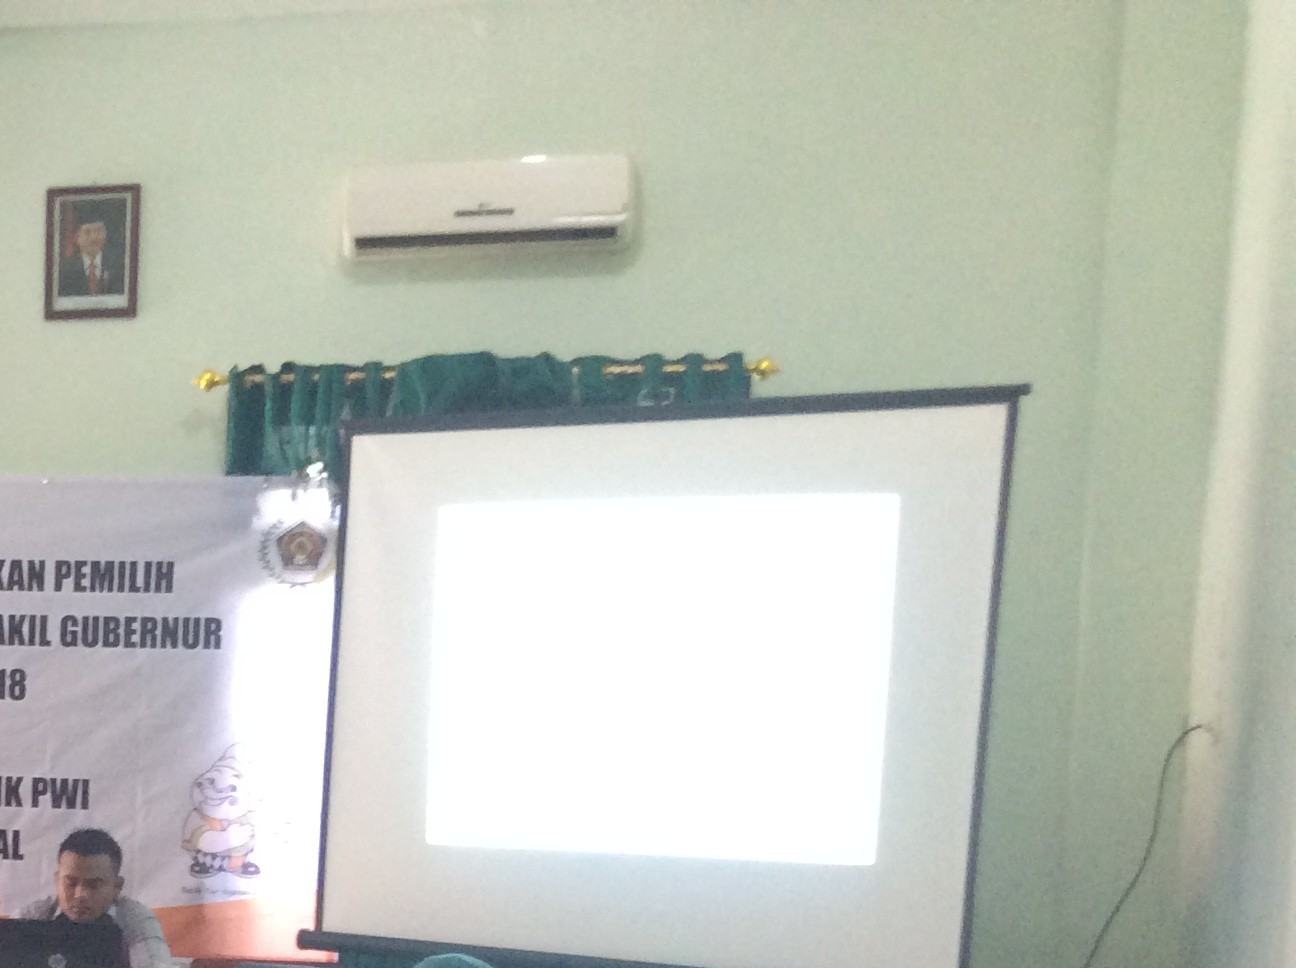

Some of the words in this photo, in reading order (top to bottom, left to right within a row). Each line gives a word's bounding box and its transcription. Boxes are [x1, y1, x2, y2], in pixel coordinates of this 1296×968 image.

[54, 560, 175, 594] PEMILIH
[60, 615, 223, 650] GUBERNUR
[31, 777, 90, 810] PWI
